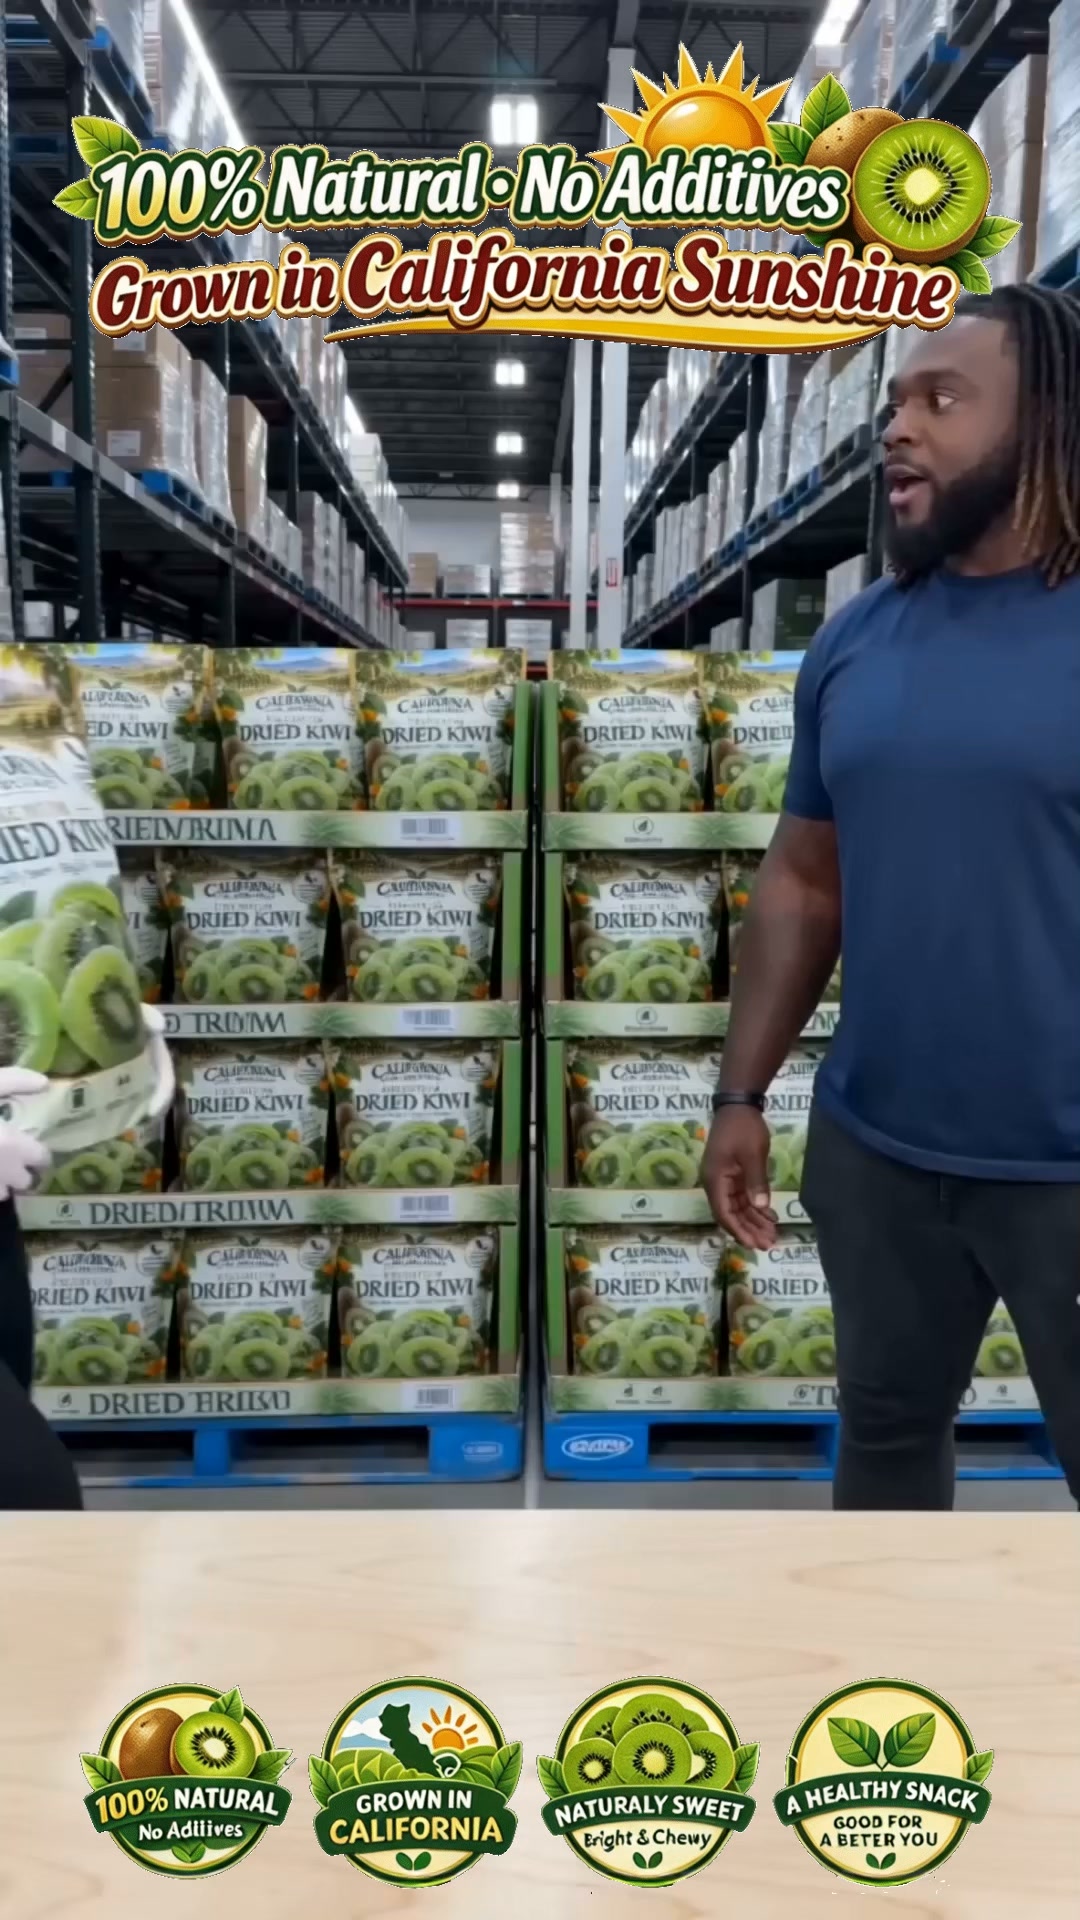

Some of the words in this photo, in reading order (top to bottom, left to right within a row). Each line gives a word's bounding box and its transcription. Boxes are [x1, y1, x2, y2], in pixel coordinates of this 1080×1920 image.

[240, 724, 300, 742] DRIED
[306, 723, 350, 741] KIWI
[383, 727, 441, 744] DRIED
[447, 725, 493, 742] KIWI
[583, 726, 645, 743] DRIED
[187, 912, 249, 930] DRIED
[360, 911, 421, 929] DRIED
[427, 910, 473, 928] KIWI
[594, 912, 657, 930] DRIED
[188, 1096, 250, 1115] DRIED
[255, 1094, 304, 1112] KIWI
[356, 1093, 418, 1112] DRIED
[423, 1091, 470, 1110] KIWI
[594, 1094, 659, 1112] DRIED
[95, 1286, 146, 1303] KIWI
[191, 1282, 253, 1300] DRIED
[258, 1279, 307, 1298] KIWI
[356, 1280, 420, 1299] DRIED
[426, 1278, 474, 1297] KIWI
[594, 1277, 660, 1297] DRIED
[665, 1276, 709, 1295] KIWI
[752, 1277, 819, 1297] DRIED
[88, 1393, 185, 1415] DRIED
